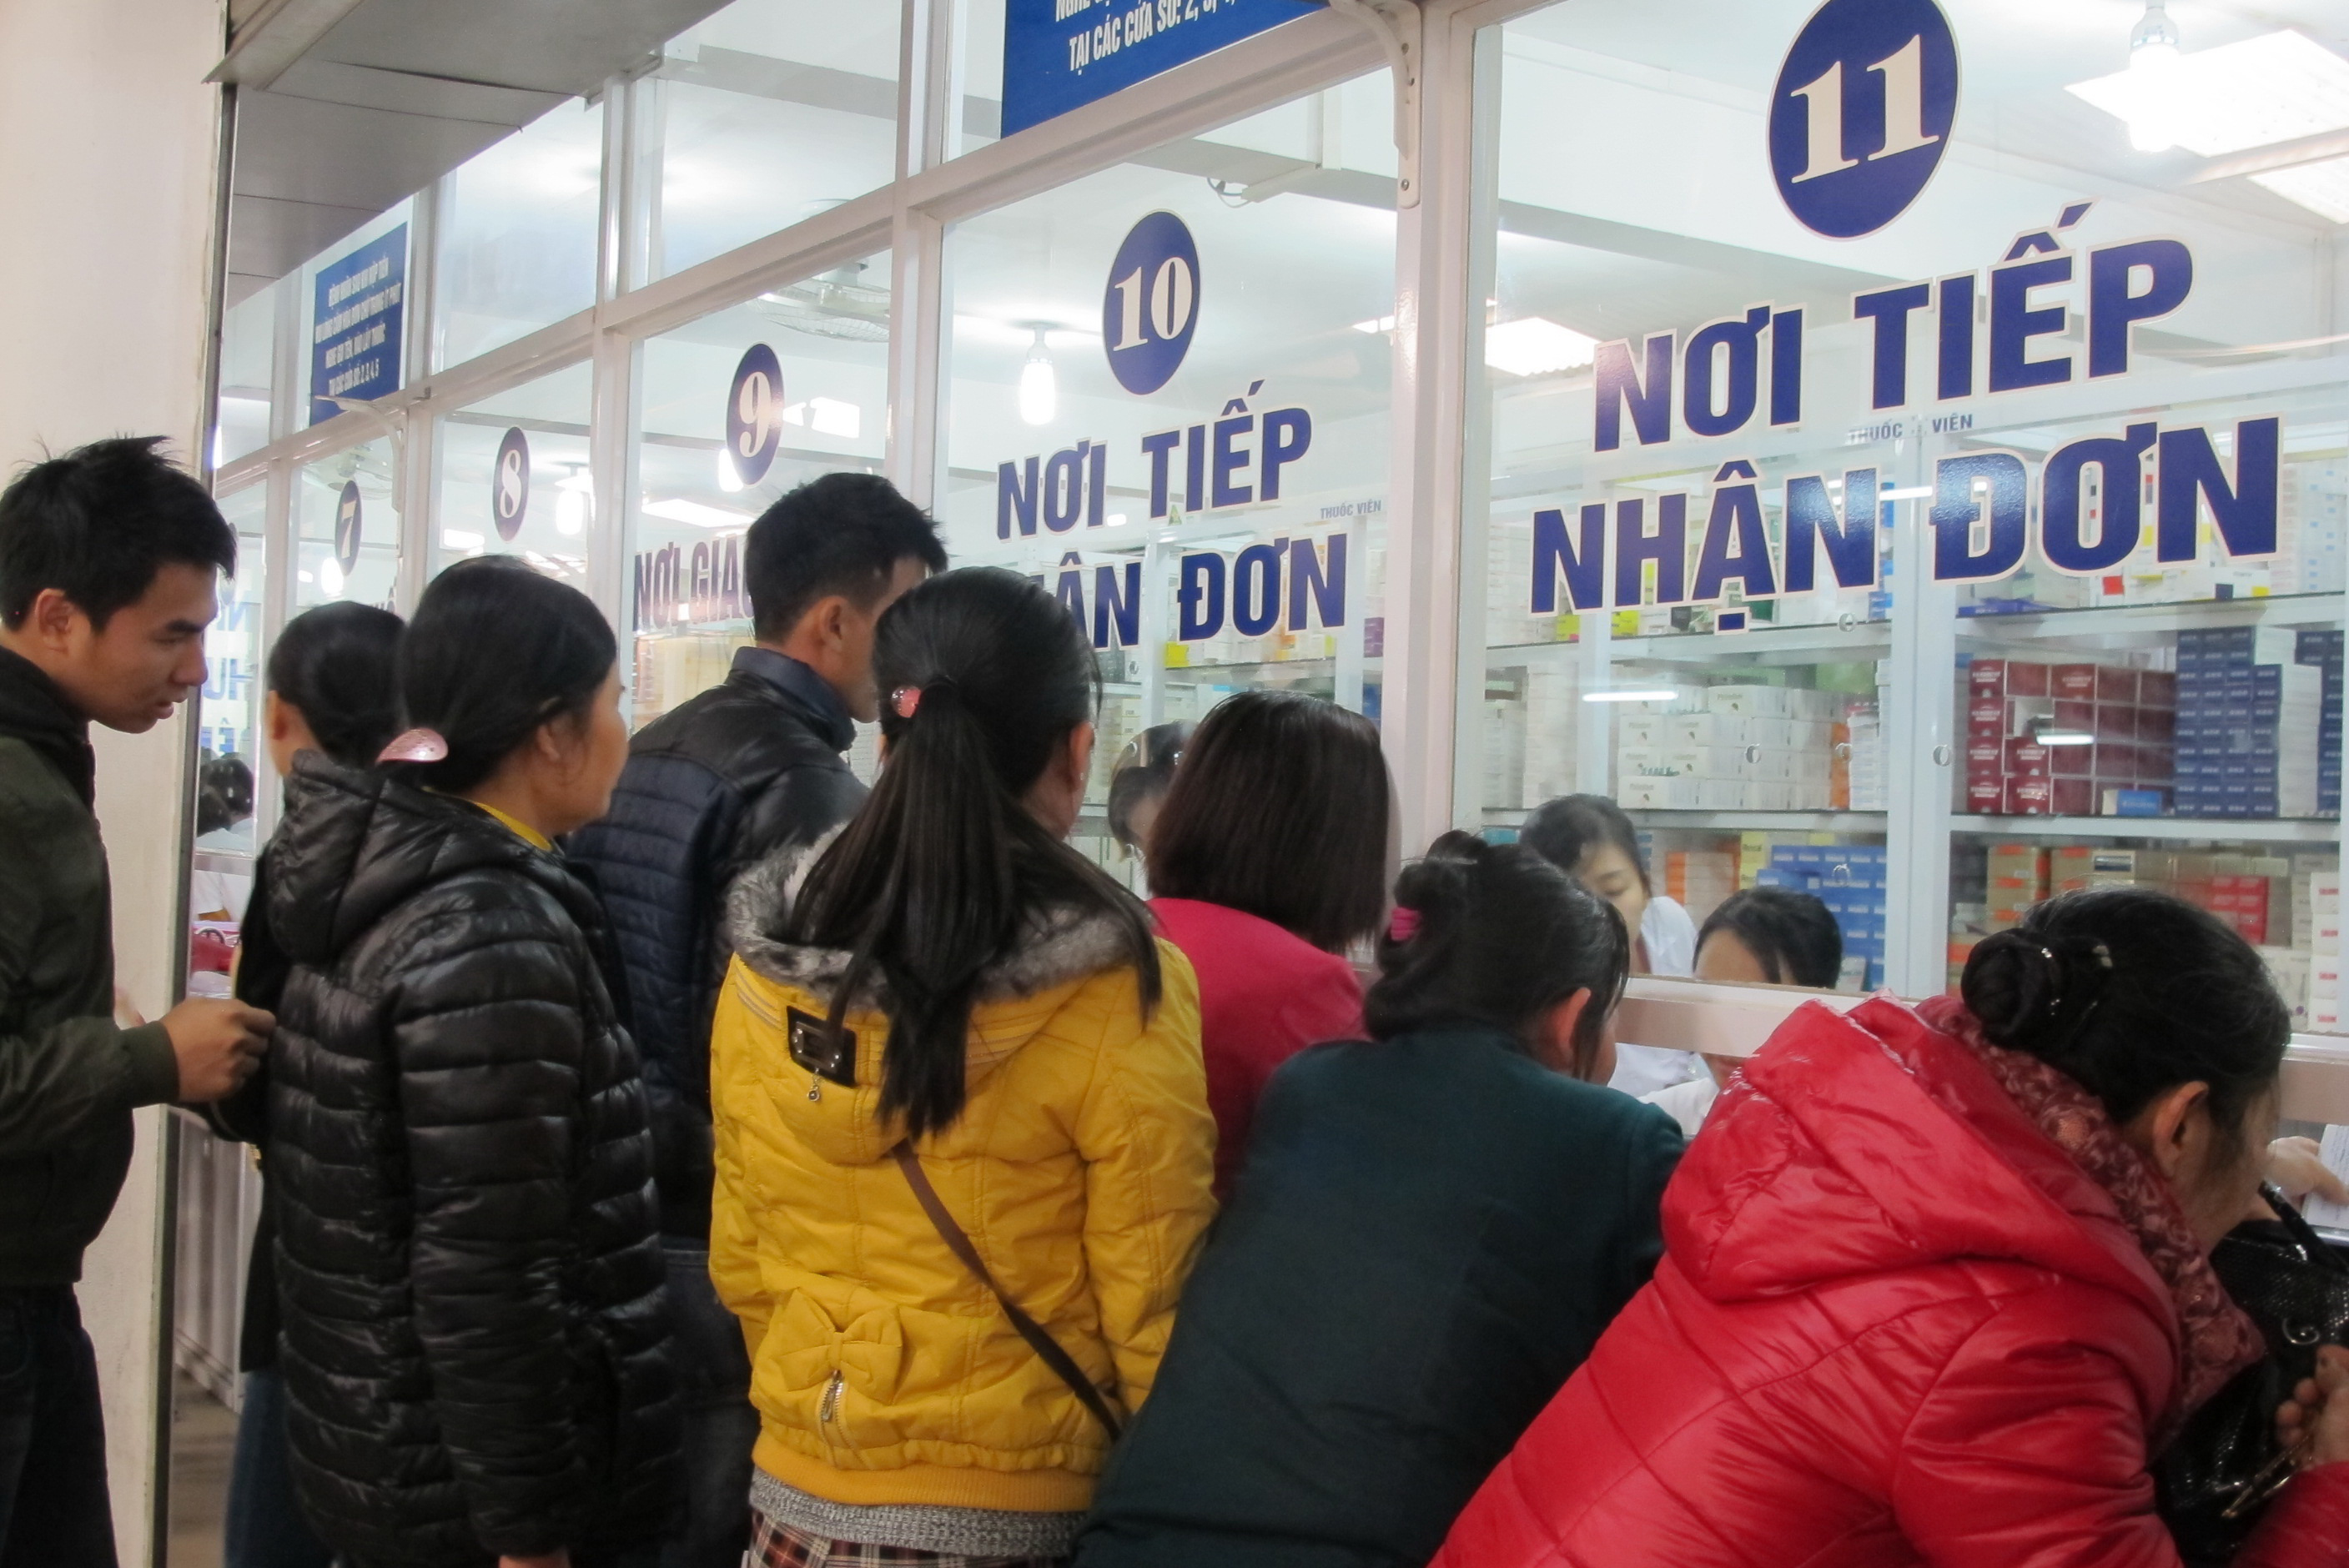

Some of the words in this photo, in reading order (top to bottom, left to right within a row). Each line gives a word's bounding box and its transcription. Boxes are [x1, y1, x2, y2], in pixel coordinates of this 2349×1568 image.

[1069, 31, 1090, 76] TẠI
[1093, 14, 1122, 61] CÁC
[1791, 34, 1939, 183] 11
[1113, 256, 1193, 351] 10
[1593, 306, 1803, 451] NƠI
[1853, 199, 2194, 410] TIẾP
[739, 371, 772, 458] 9
[996, 440, 1107, 540] NƠI
[1141, 379, 1311, 520] TIẾP
[1848, 419, 1904, 441] THUỐC
[1932, 412, 1973, 434] VIÊN
[340, 500, 357, 560] 7
[500, 449, 522, 519] 8
[1320, 500, 1354, 520] THUỐC
[1530, 459, 1878, 631] NHẬN
[1928, 417, 2280, 580] ĐƠN
[631, 541, 681, 632] NƠI
[691, 533, 754, 625] GIA
[1177, 533, 1348, 641] ĐƠN
